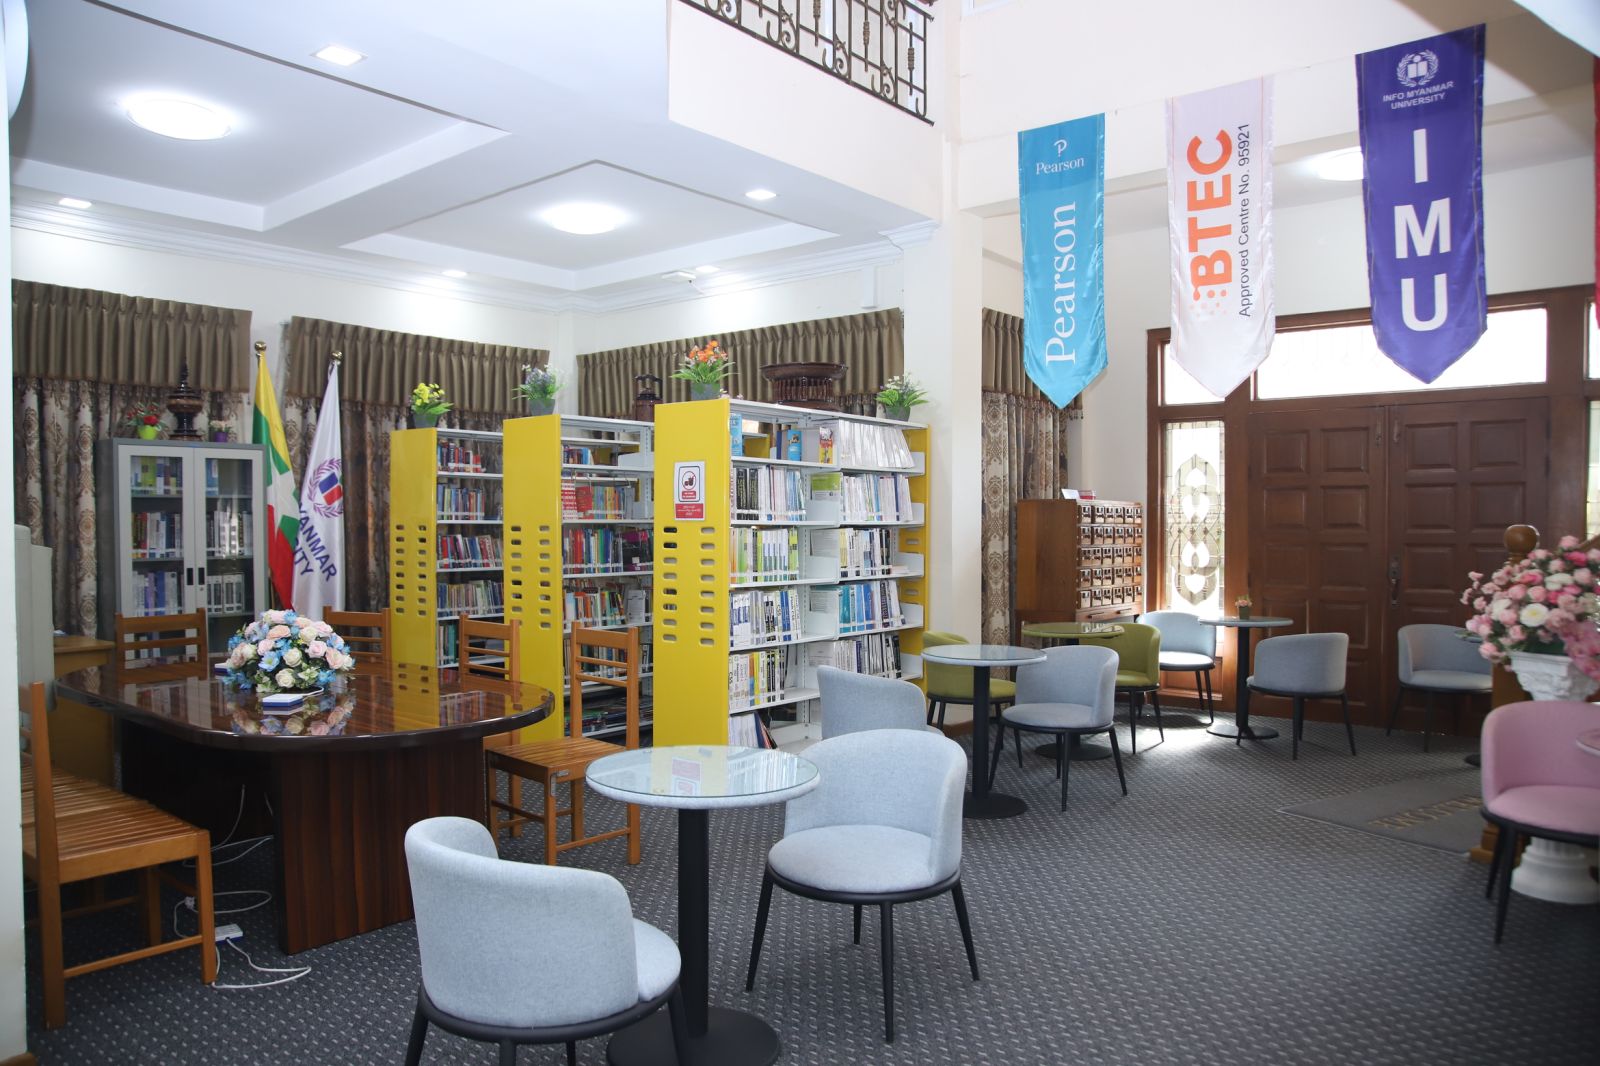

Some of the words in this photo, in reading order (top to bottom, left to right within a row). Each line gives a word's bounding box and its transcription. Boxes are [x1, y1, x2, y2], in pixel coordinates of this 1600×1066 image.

[1383, 92, 1405, 102] INFO
[1406, 81, 1454, 98] MYANMAR
[1391, 92, 1446, 110] UNIVERSITY
[1035, 157, 1084, 175] Pearson
[1237, 124, 1250, 167] 95921
[1238, 170, 1250, 195] No.
[1187, 129, 1233, 287] BTEC
[1238, 198, 1250, 246] Centre
[1045, 201, 1076, 364] Pearson
[1239, 250, 1253, 317] Approved
[299, 503, 337, 582] YANMAR
